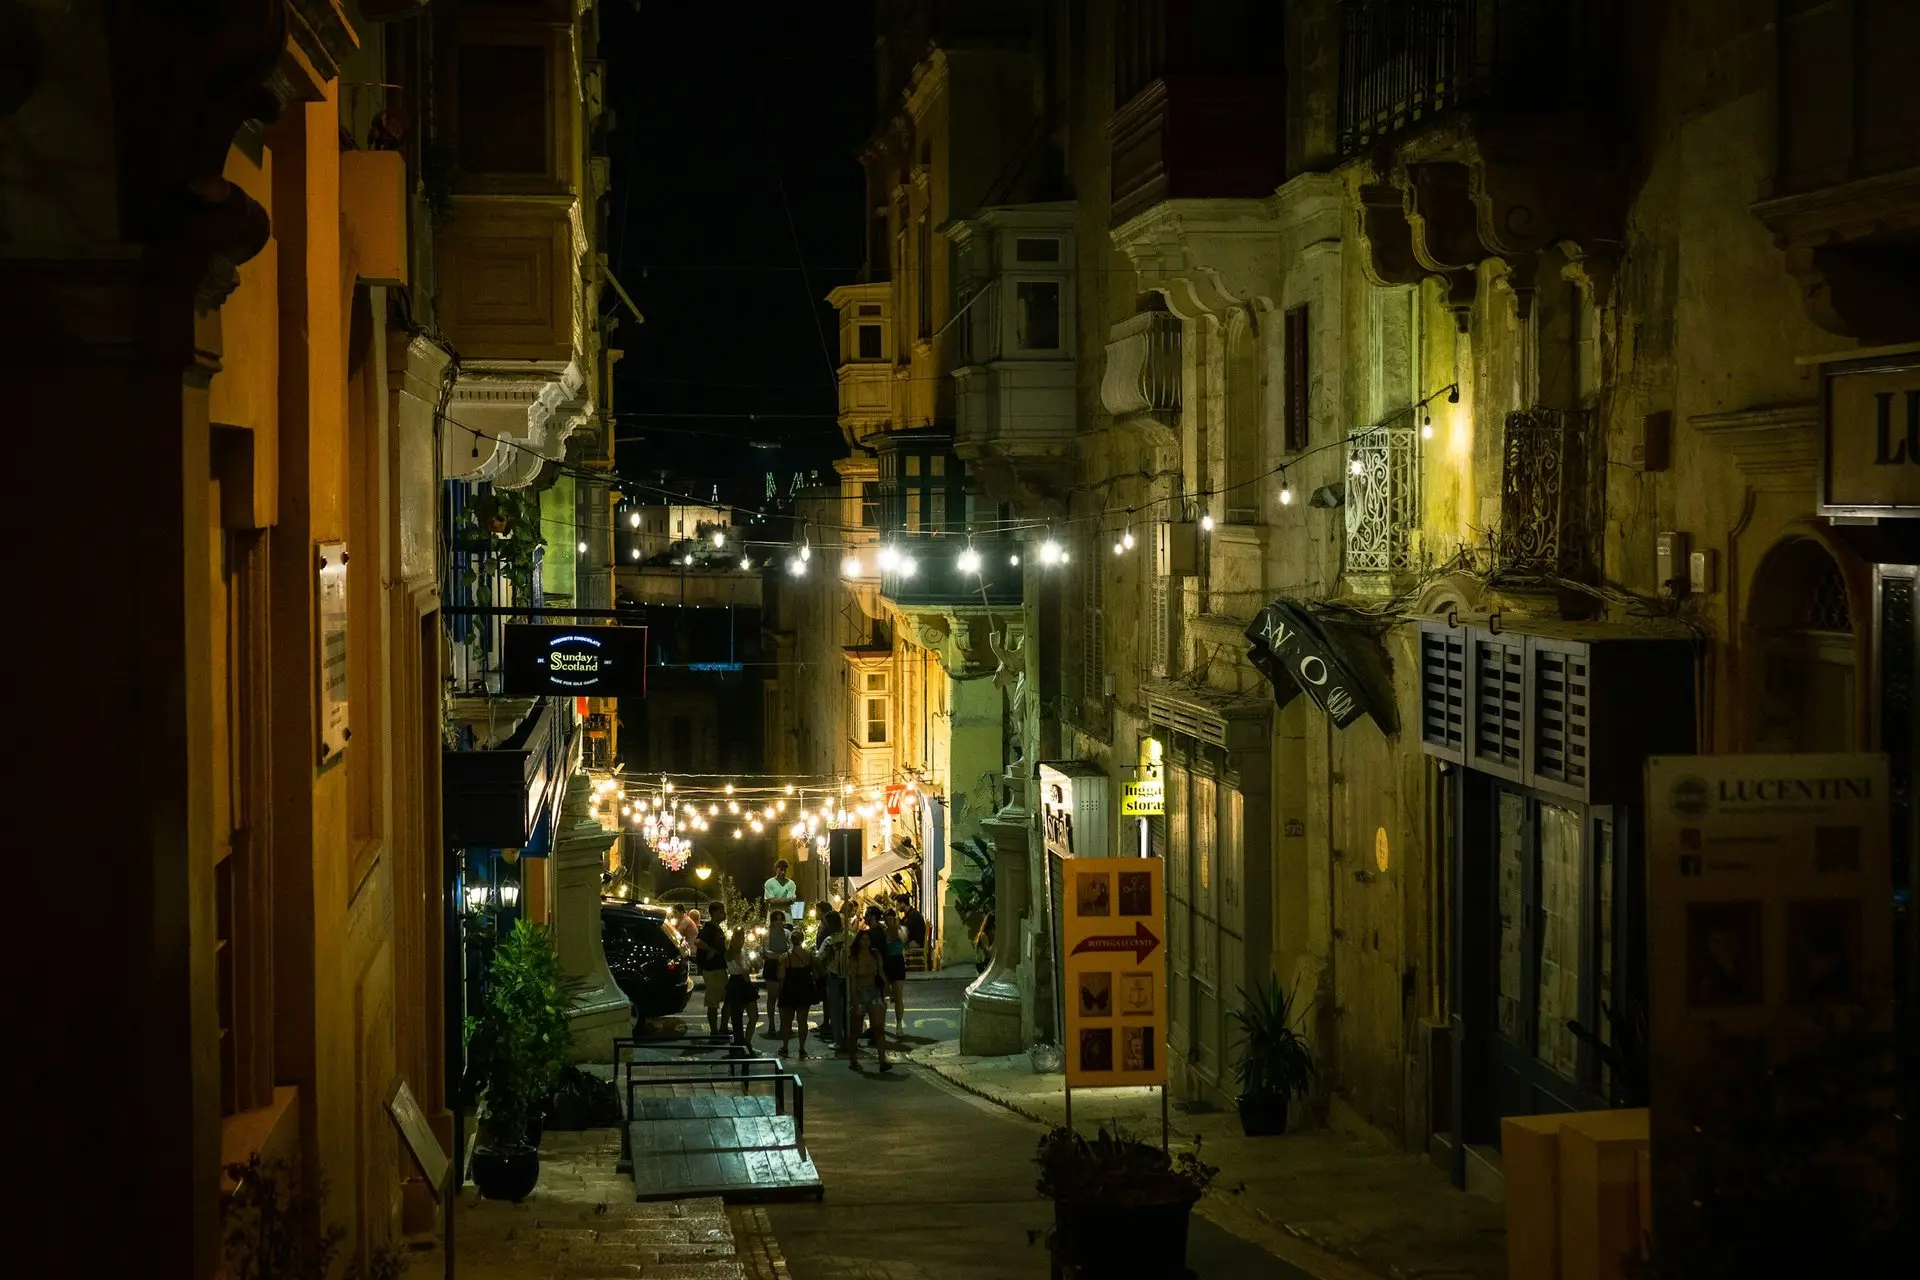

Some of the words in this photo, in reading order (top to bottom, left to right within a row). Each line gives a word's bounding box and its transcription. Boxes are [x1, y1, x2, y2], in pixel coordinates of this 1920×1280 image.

[574, 636, 601, 647] CHOCOLATE
[1125, 785, 1163, 798] lugga
[1719, 777, 1873, 802] LUCENTINI
